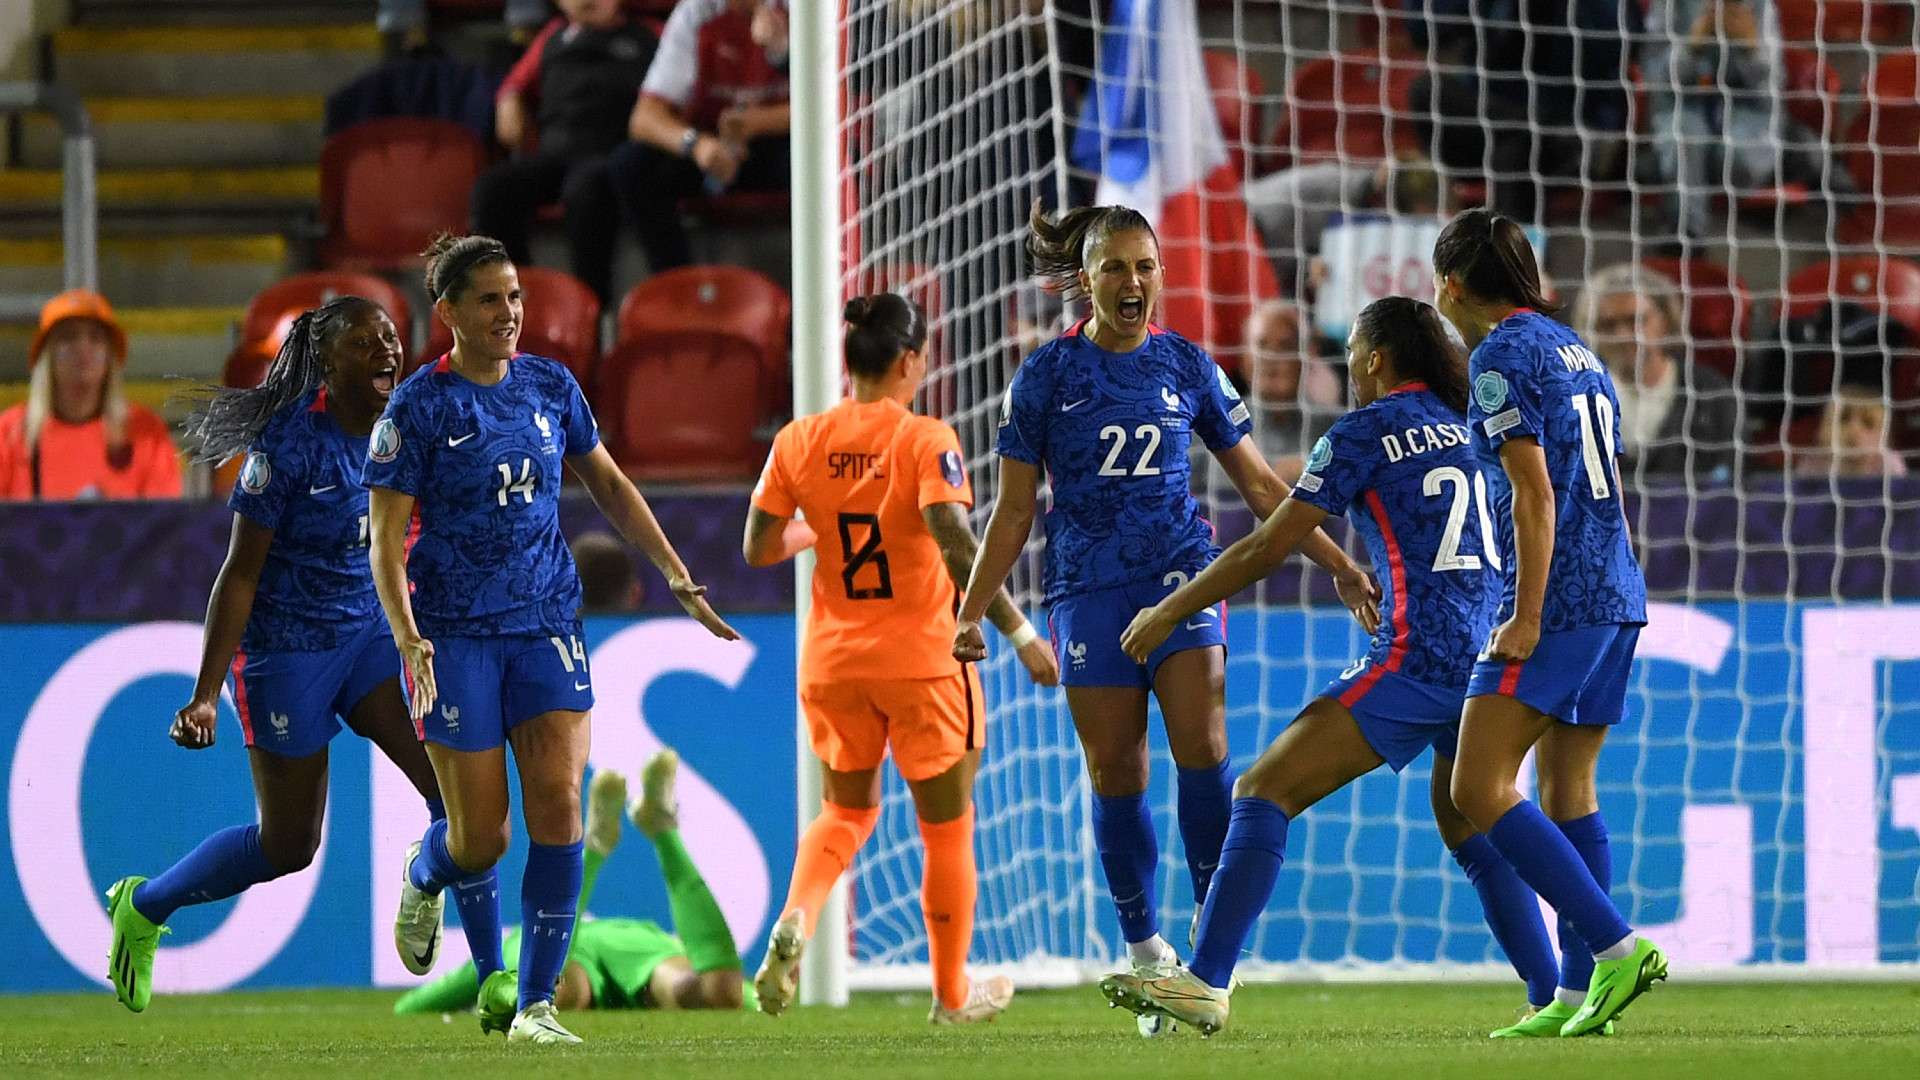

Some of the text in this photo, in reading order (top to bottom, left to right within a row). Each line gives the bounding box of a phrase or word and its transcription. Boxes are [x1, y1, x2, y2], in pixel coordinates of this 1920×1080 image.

[1097, 424, 1161, 476] 22
[498, 458, 535, 507] 14
[837, 512, 894, 599] 8
[551, 635, 587, 672] 14
